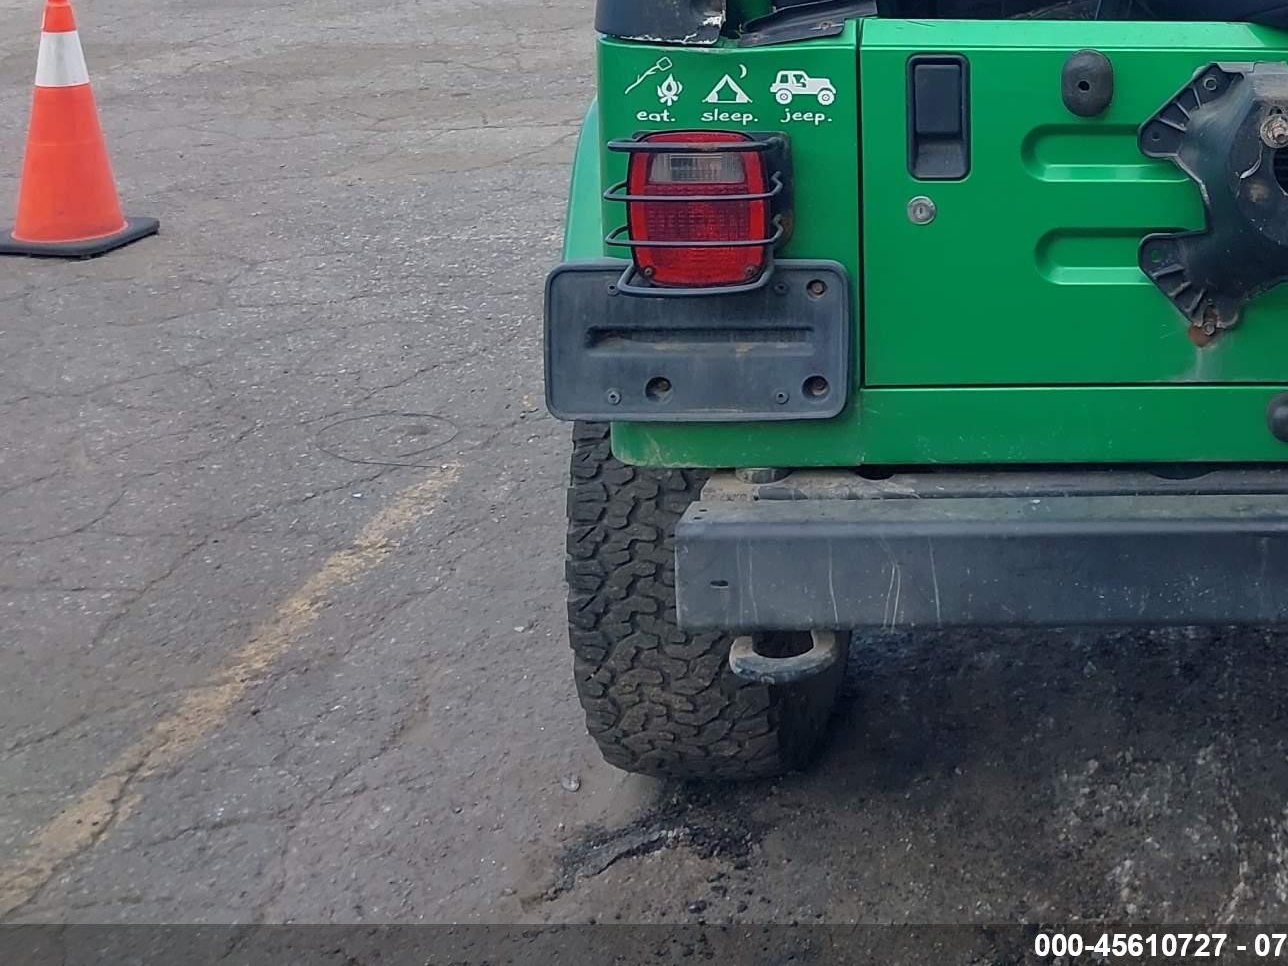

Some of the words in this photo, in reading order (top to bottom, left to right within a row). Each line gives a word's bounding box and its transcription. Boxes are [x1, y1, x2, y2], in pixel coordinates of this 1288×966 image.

[637, 110, 676, 123] eat.
[701, 109, 759, 126] sleep.
[780, 109, 832, 126] jeep.
